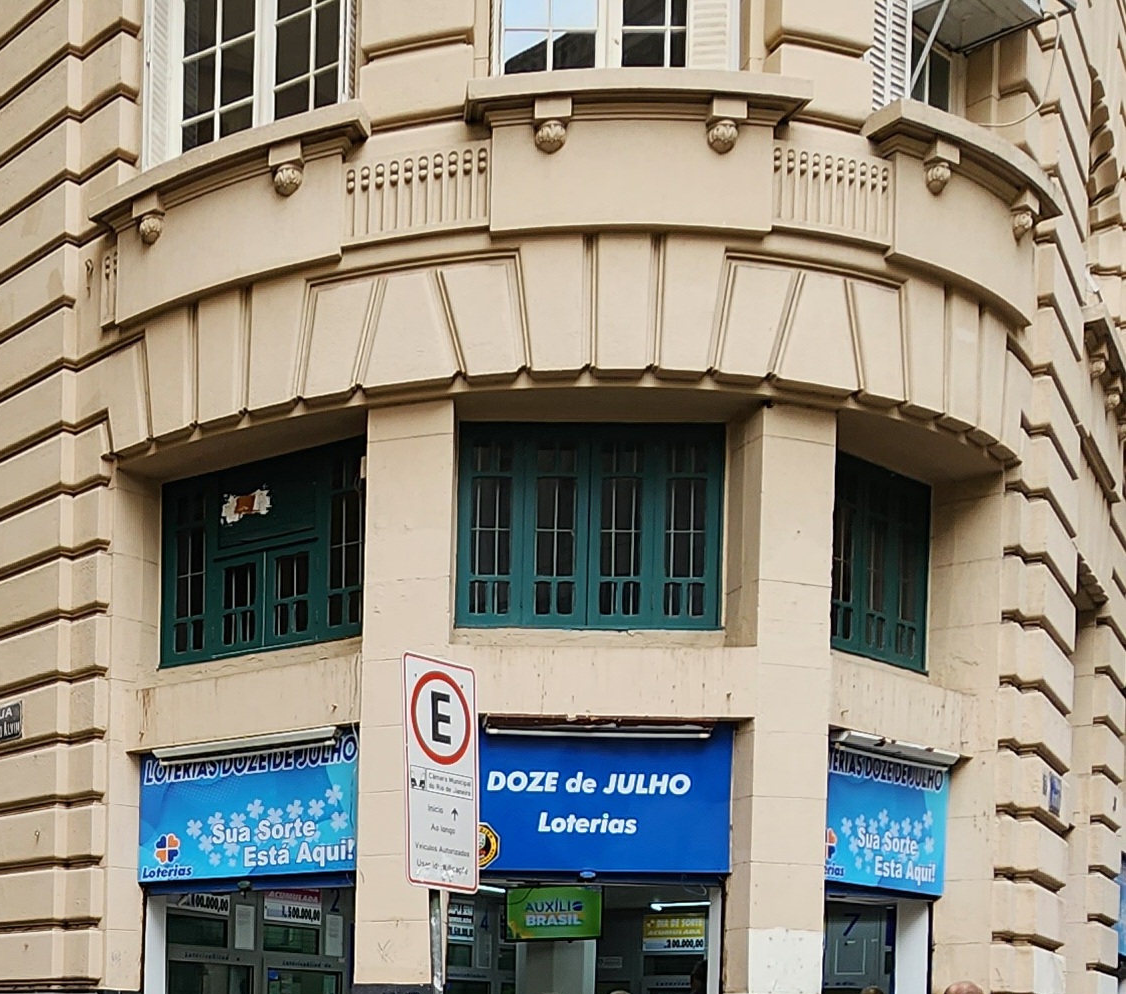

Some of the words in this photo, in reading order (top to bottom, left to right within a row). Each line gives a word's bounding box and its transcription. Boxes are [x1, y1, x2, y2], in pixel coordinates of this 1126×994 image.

[431, 690, 452, 745] E
[220, 753, 268, 778] DOZE
[270, 749, 294, 772] DE
[296, 735, 358, 770] JULHO
[487, 771, 559, 792] DOZE
[565, 772, 597, 793] de
[603, 773, 692, 795] JULHO
[212, 823, 250, 844] Sua
[258, 818, 316, 841] Sorte
[538, 812, 637, 834] Loterias
[244, 842, 289, 867] Está
[297, 839, 354, 866] Aqui!
[857, 827, 880, 849] Sua
[884, 831, 918, 857] Sorte
[143, 865, 192, 880] Loterias
[824, 863, 844, 877] erias
[905, 860, 936, 885] Aqui!
[267, 891, 319, 903] ACUMULADA
[330, 888, 341, 912] 2
[480, 909, 489, 931] 4
[526, 914, 582, 926] BRASIL
[843, 913, 861, 936] 7
